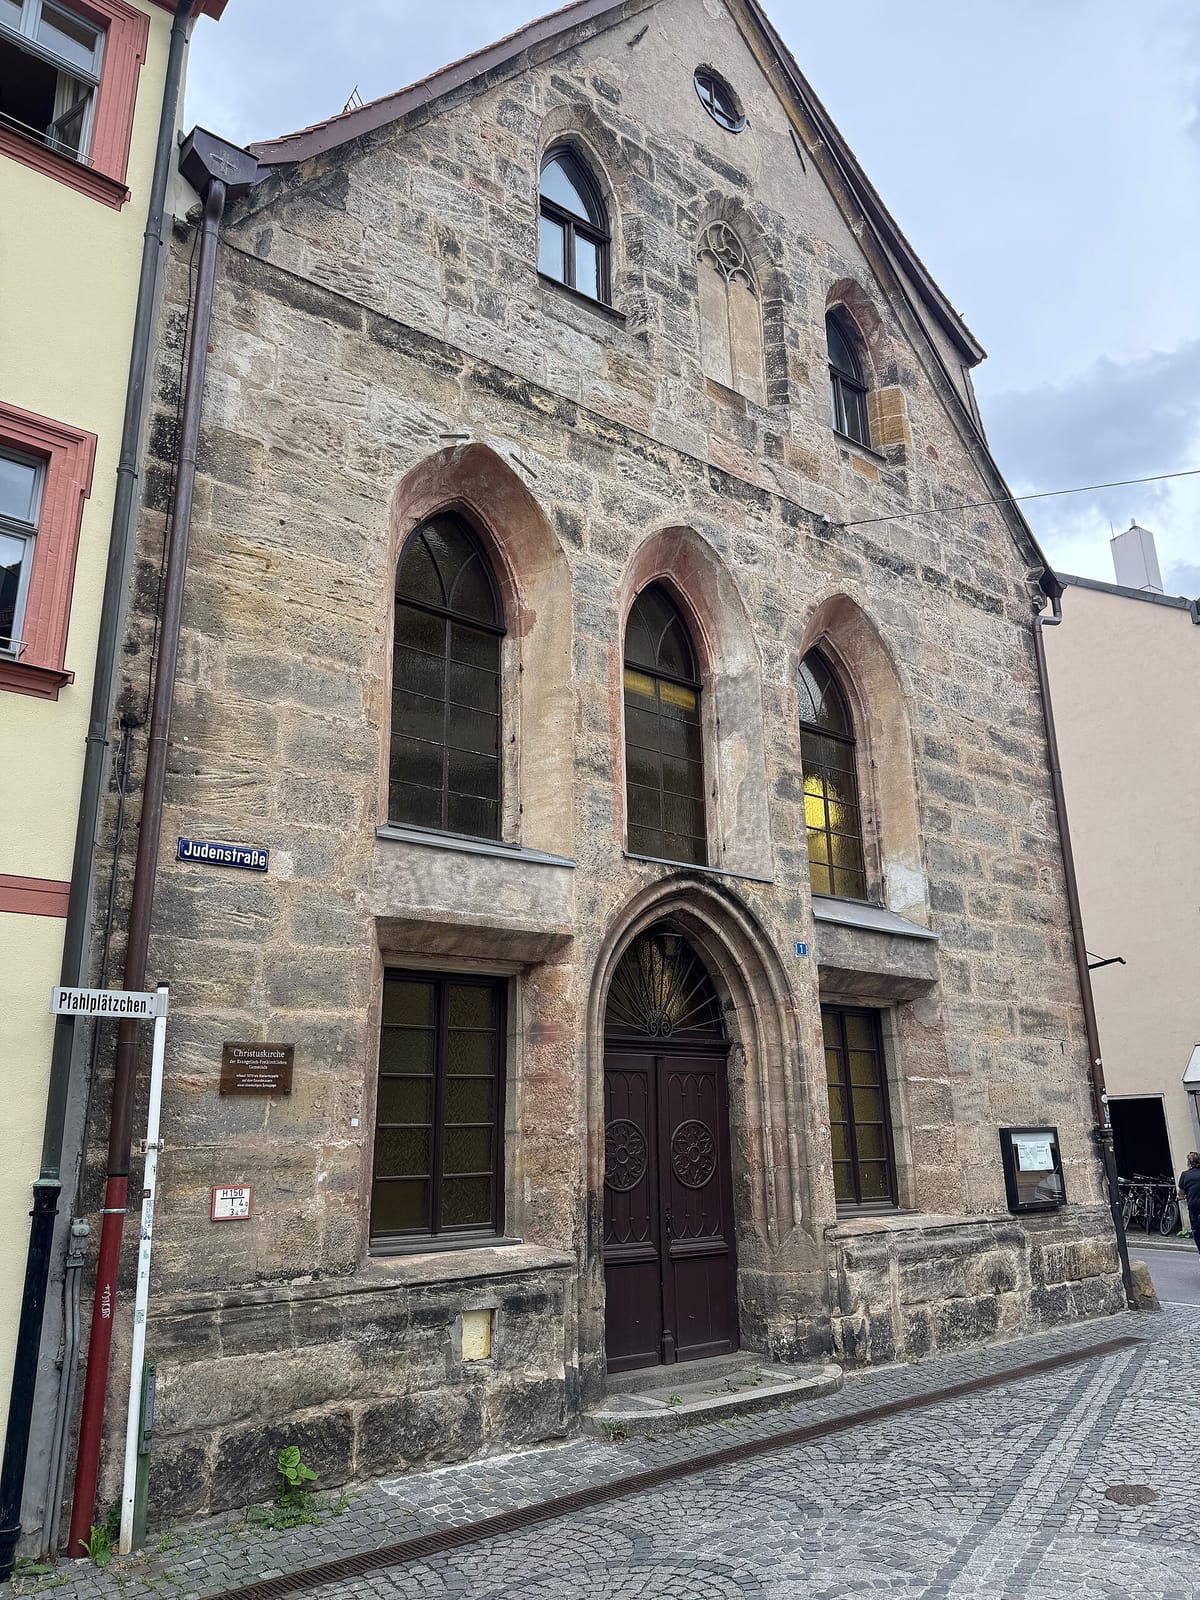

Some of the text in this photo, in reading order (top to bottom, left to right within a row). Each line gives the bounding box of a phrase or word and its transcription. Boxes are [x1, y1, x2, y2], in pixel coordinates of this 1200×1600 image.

[184, 841, 266, 866] Judenstraße
[59, 991, 147, 1013] Pfahlplätzchen
[233, 1048, 285, 1058] Christuskirche
